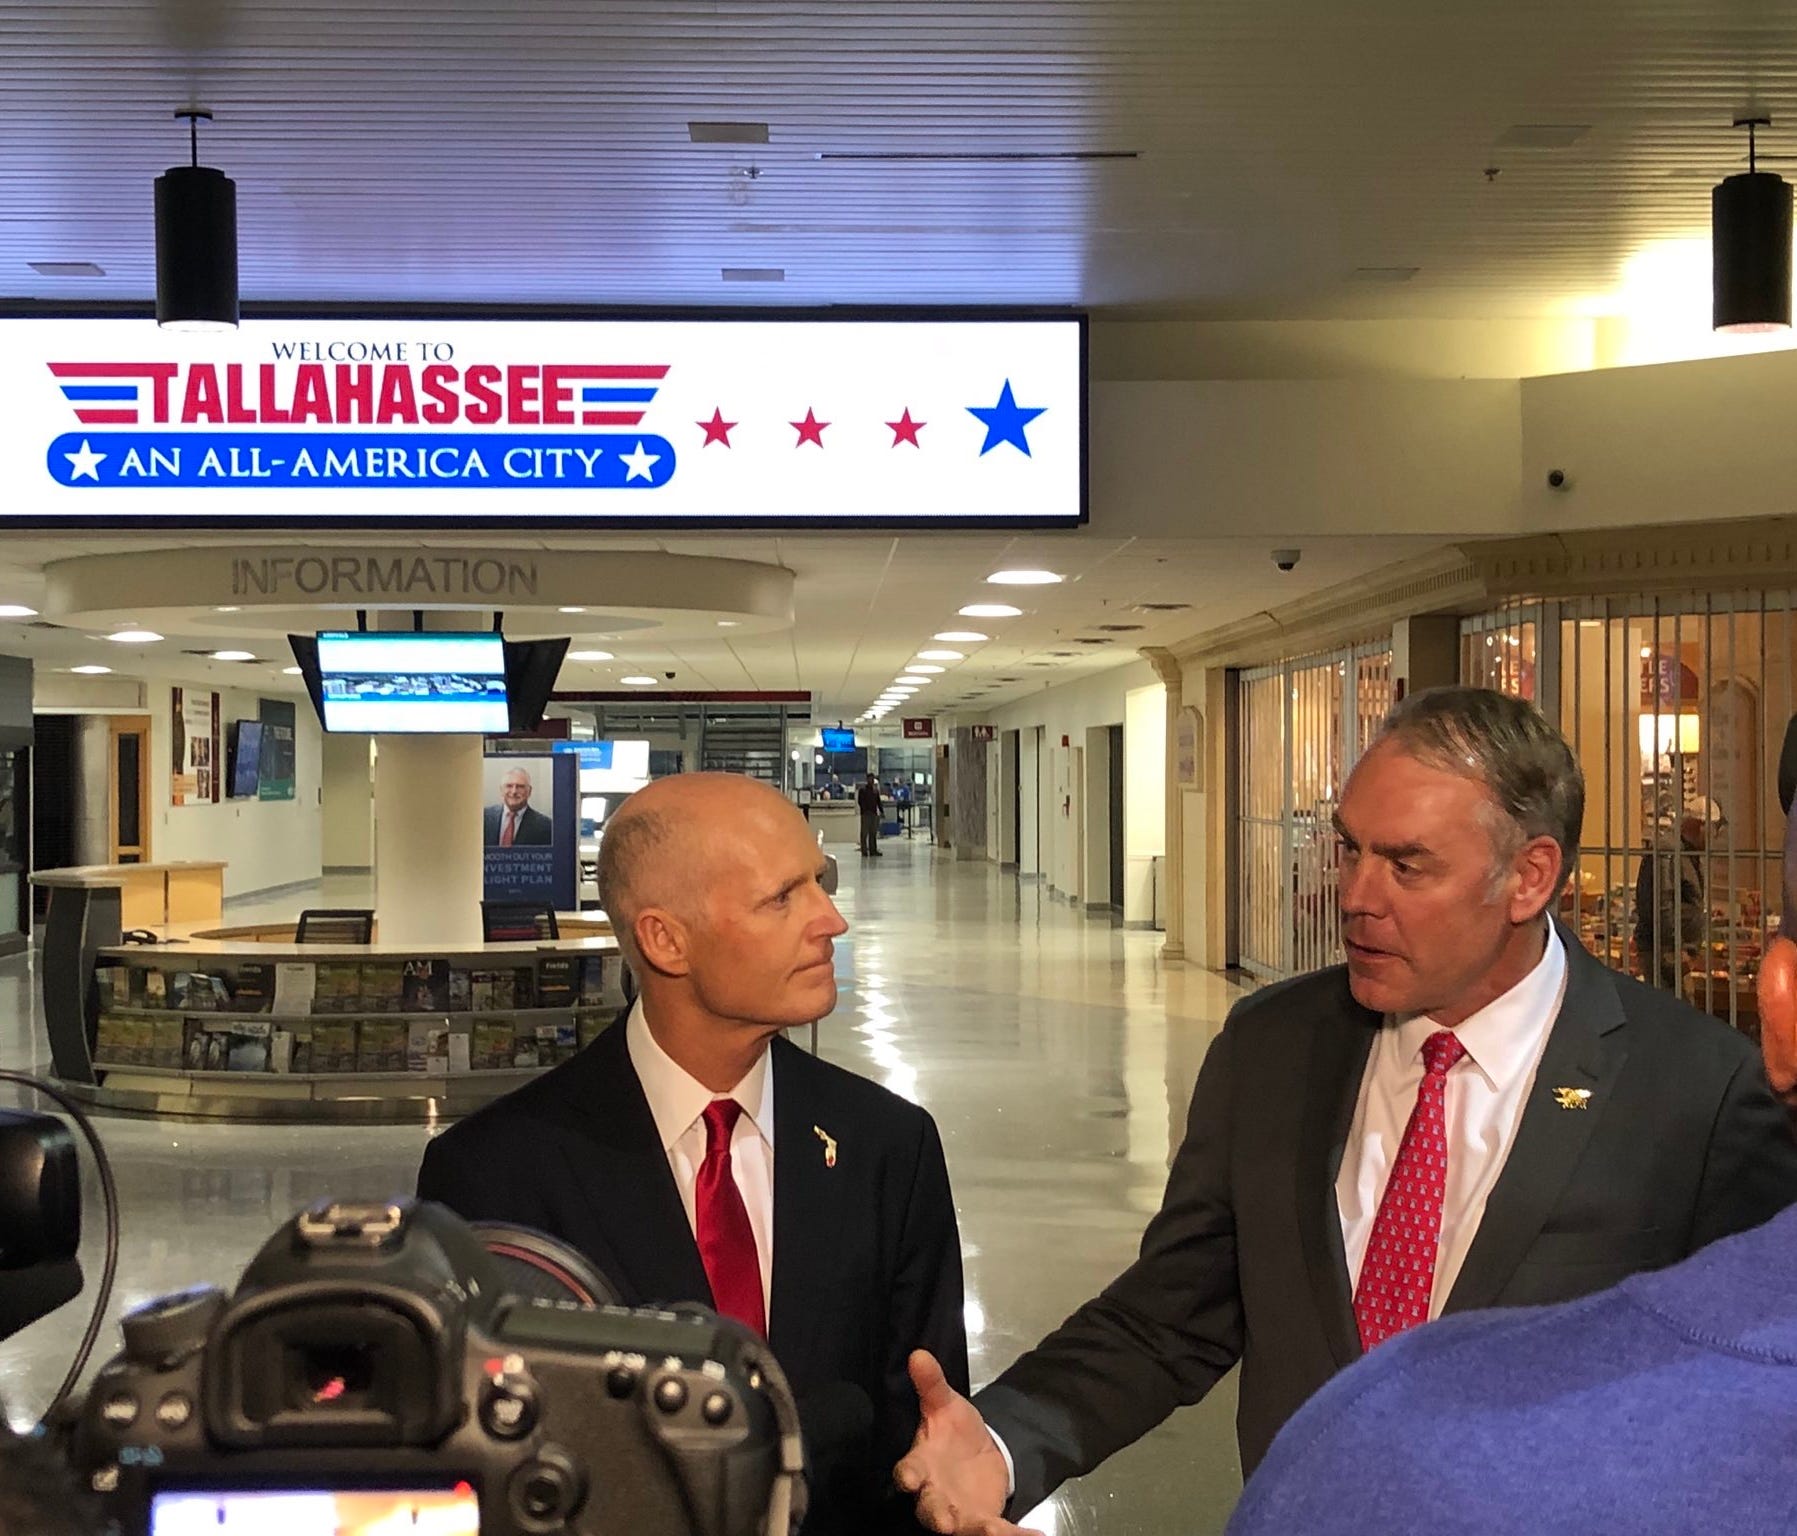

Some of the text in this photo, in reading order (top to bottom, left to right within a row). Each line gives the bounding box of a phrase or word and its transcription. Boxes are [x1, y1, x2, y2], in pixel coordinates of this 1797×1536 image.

[272, 342, 454, 361] WELCOME TO
[136, 362, 575, 425] TALLAHASSEE
[118, 447, 603, 479] AN ALL-AMERICA CITY
[231, 556, 538, 595] INFORMATION
